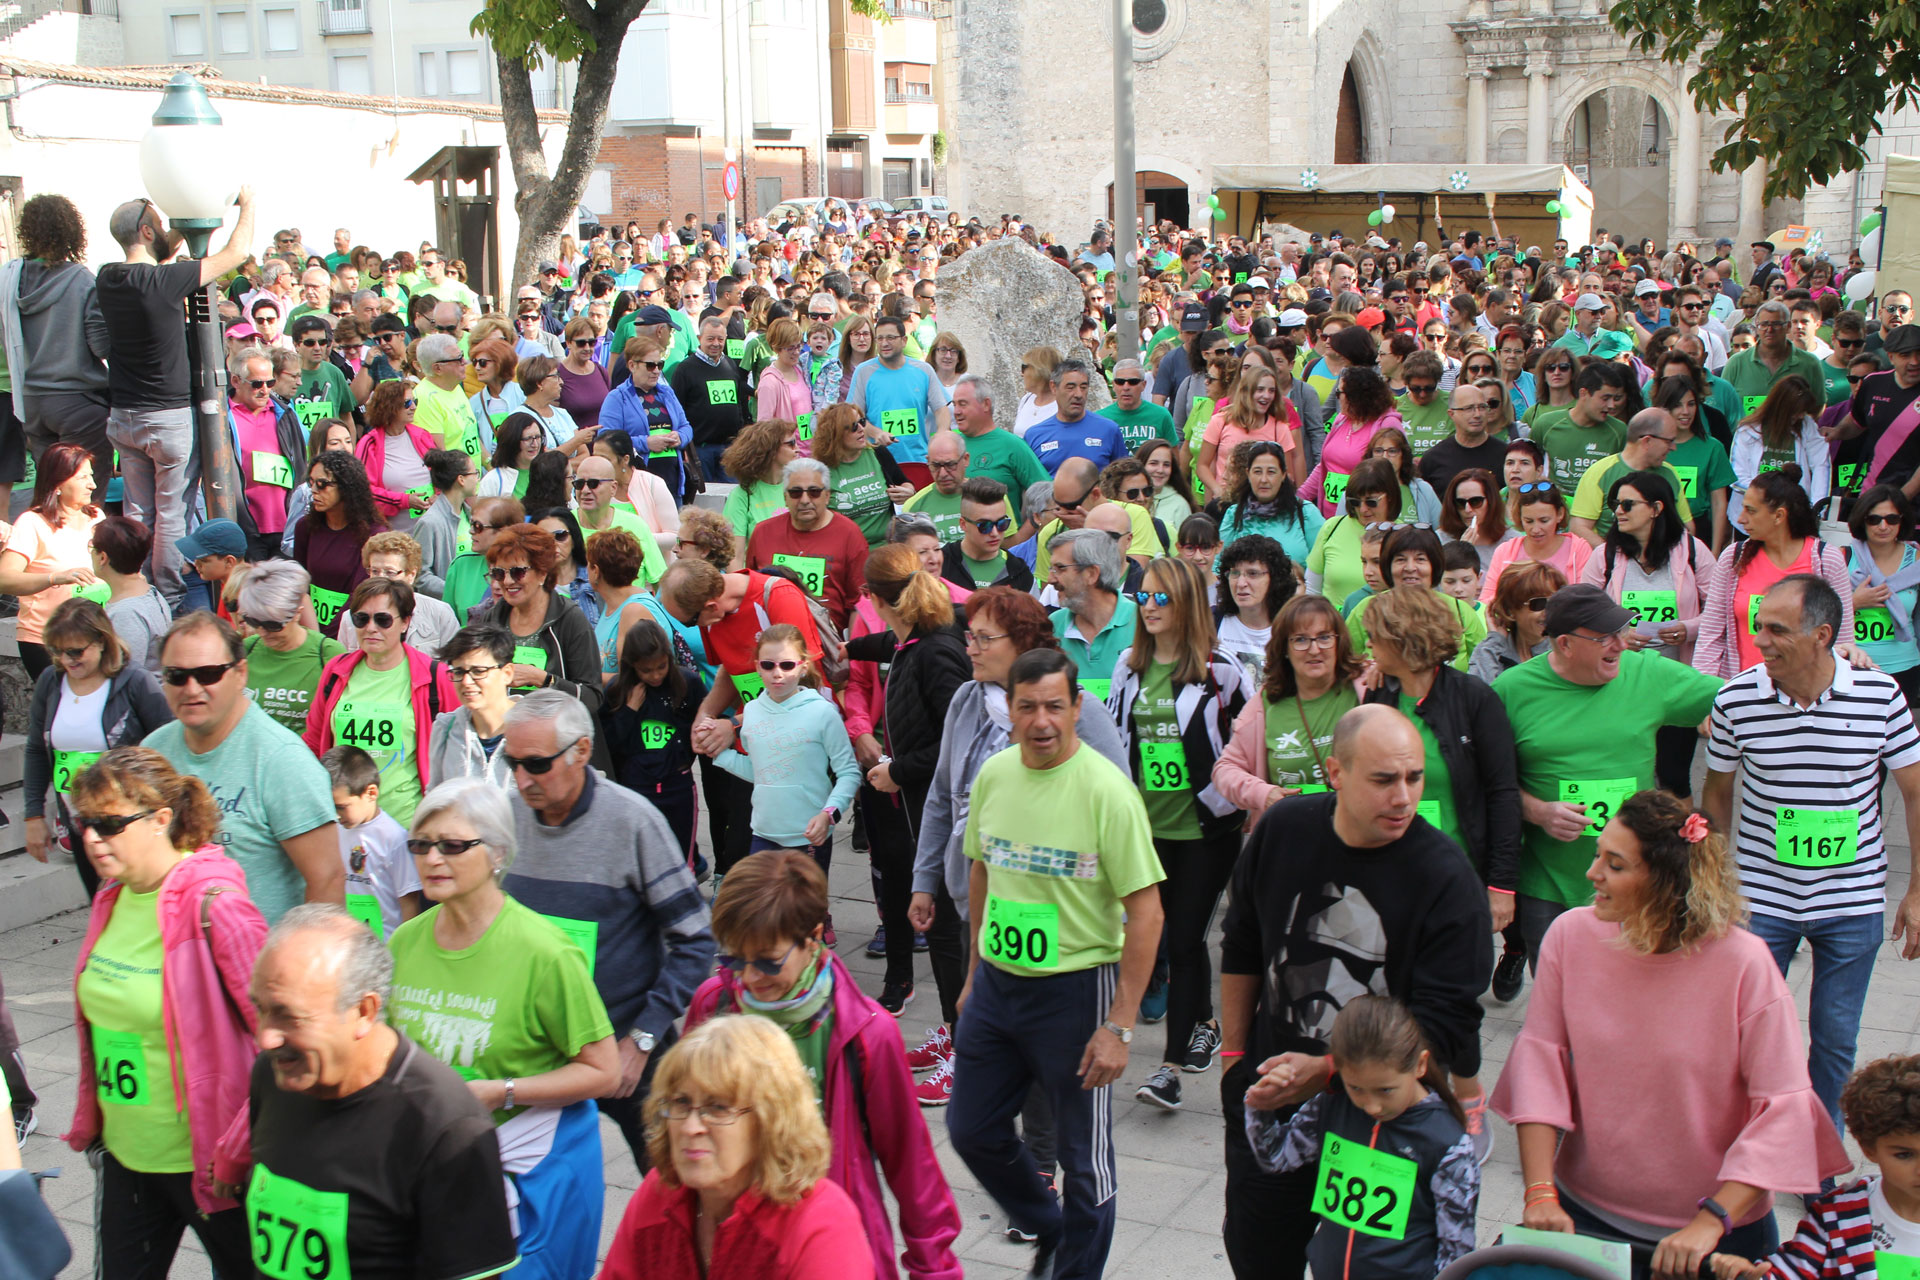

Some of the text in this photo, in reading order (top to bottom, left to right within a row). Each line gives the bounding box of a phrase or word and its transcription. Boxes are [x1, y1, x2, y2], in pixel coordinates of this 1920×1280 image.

[712, 389, 737, 403] 812
[885, 418, 917, 435] 715
[1122, 424, 1156, 441] ELAND
[1575, 457, 1598, 467] aec
[853, 481, 883, 497] aecc
[949, 526, 963, 537] ae
[263, 687, 309, 704] aecc
[342, 718, 395, 747] 448
[642, 725, 674, 743] 195
[1156, 722, 1180, 737] ae
[1150, 761, 1190, 789] 39
[1788, 835, 1847, 859] 1167
[989, 920, 1048, 963] 390
[1323, 1167, 1398, 1232] 582
[256, 1210, 331, 1280] 579
